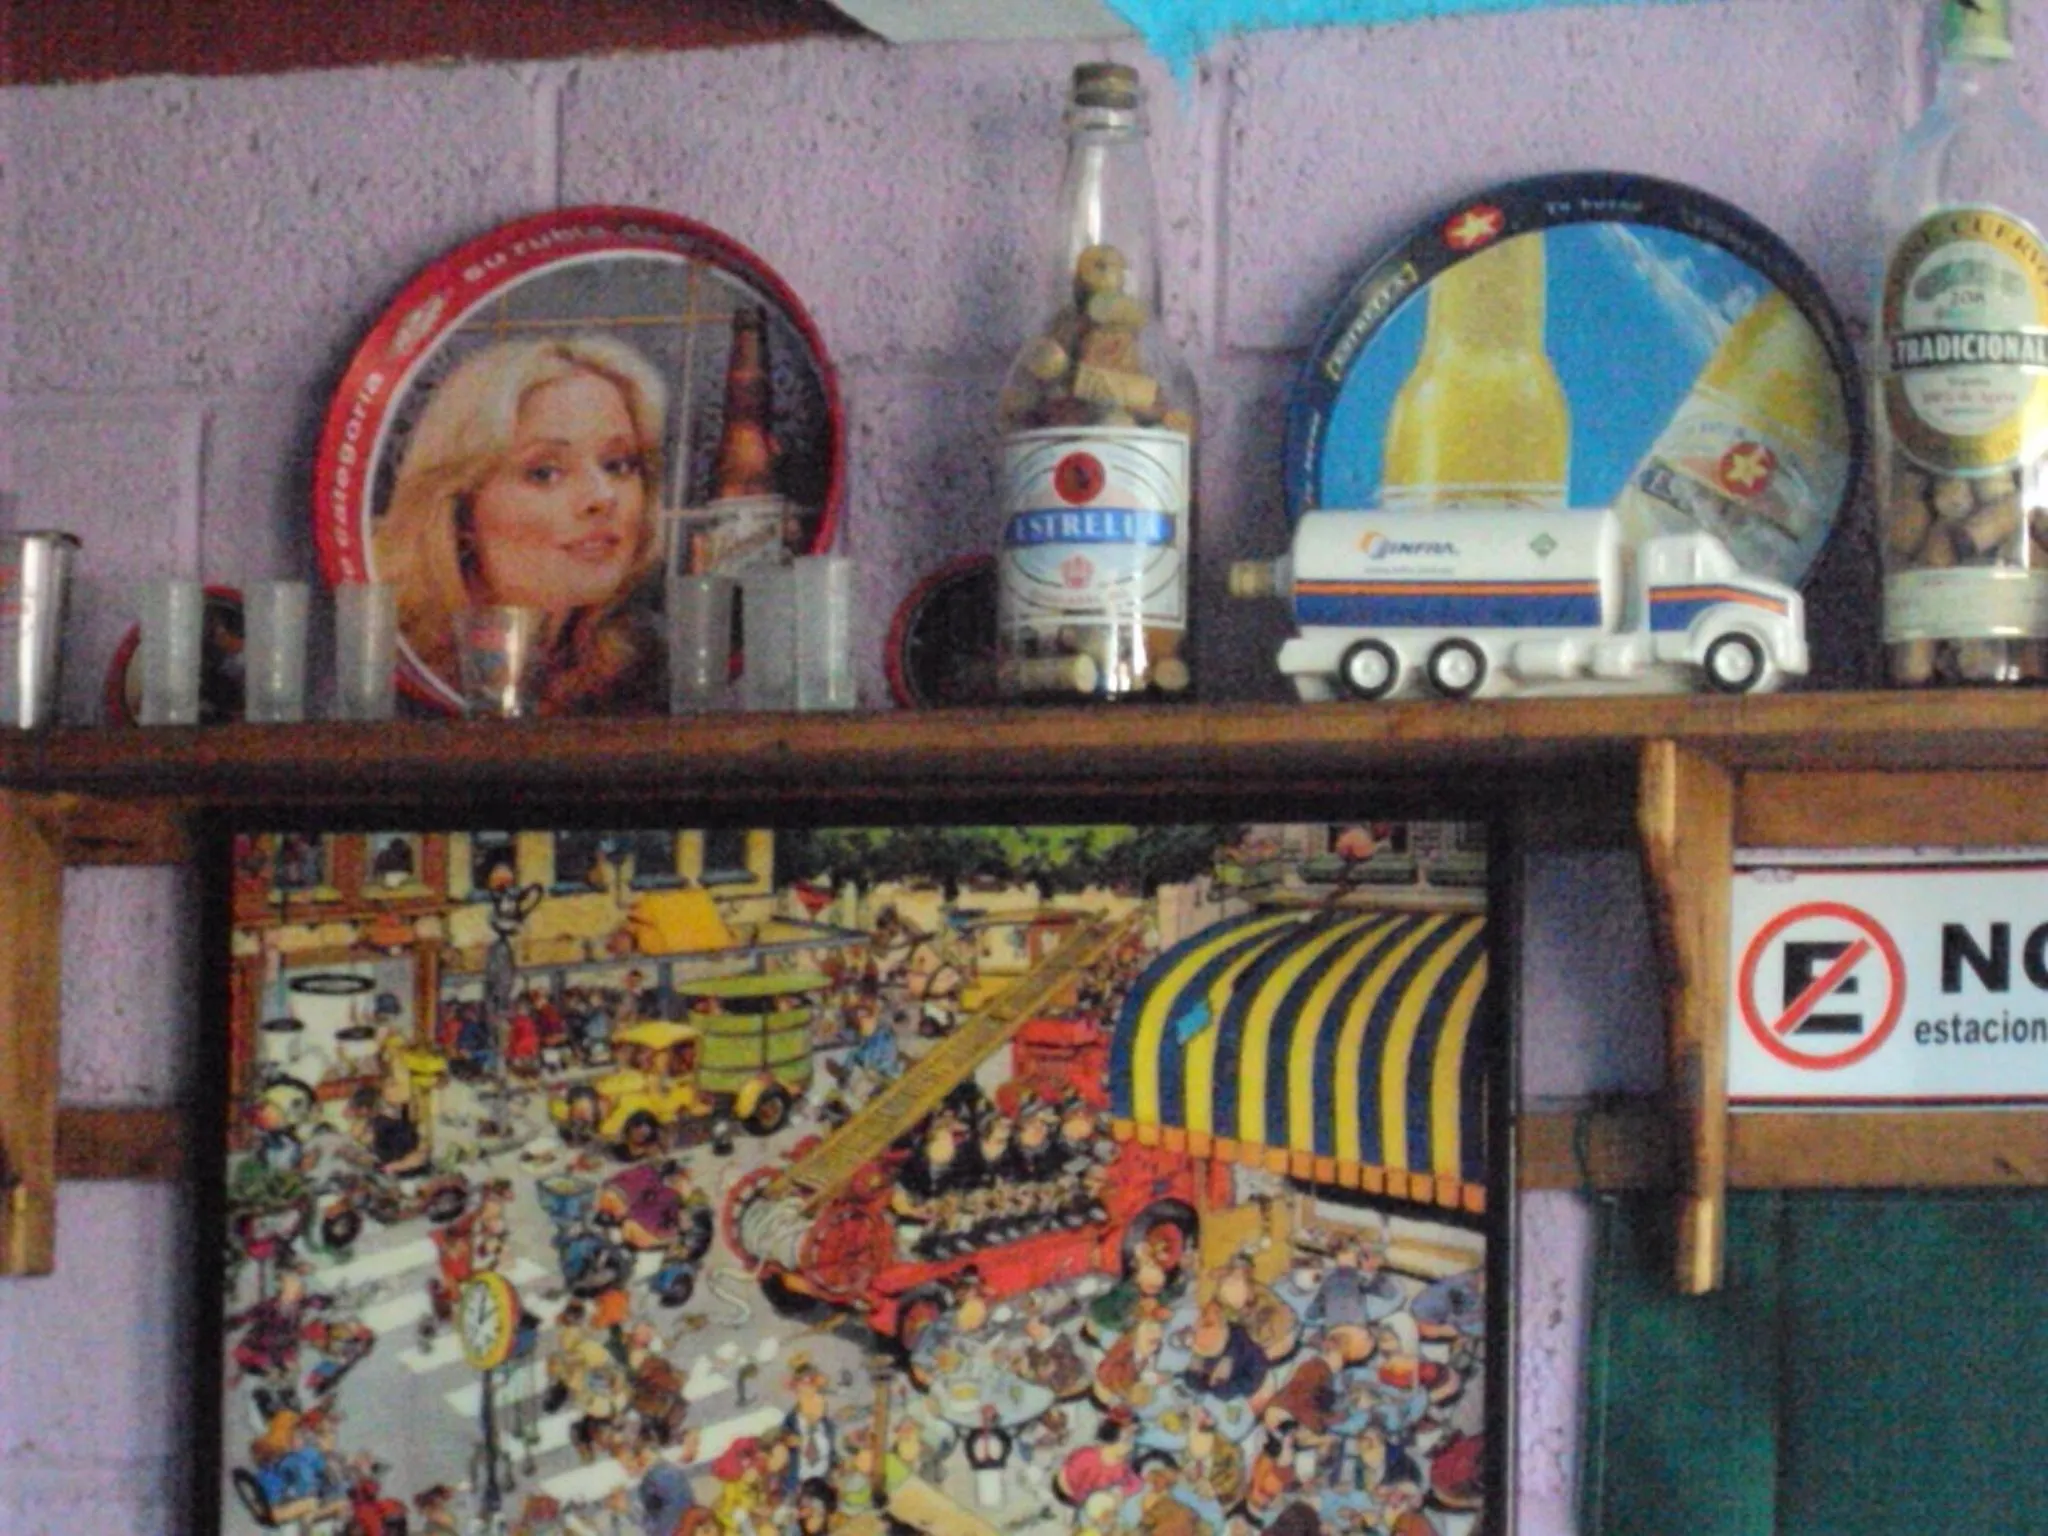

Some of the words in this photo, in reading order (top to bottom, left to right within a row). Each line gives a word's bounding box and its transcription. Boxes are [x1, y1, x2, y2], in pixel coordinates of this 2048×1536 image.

[1897, 332, 2048, 364] TRADICIONAL
[1015, 512, 1162, 540] ESTRELLA
[1914, 1010, 2048, 1045] estacion
